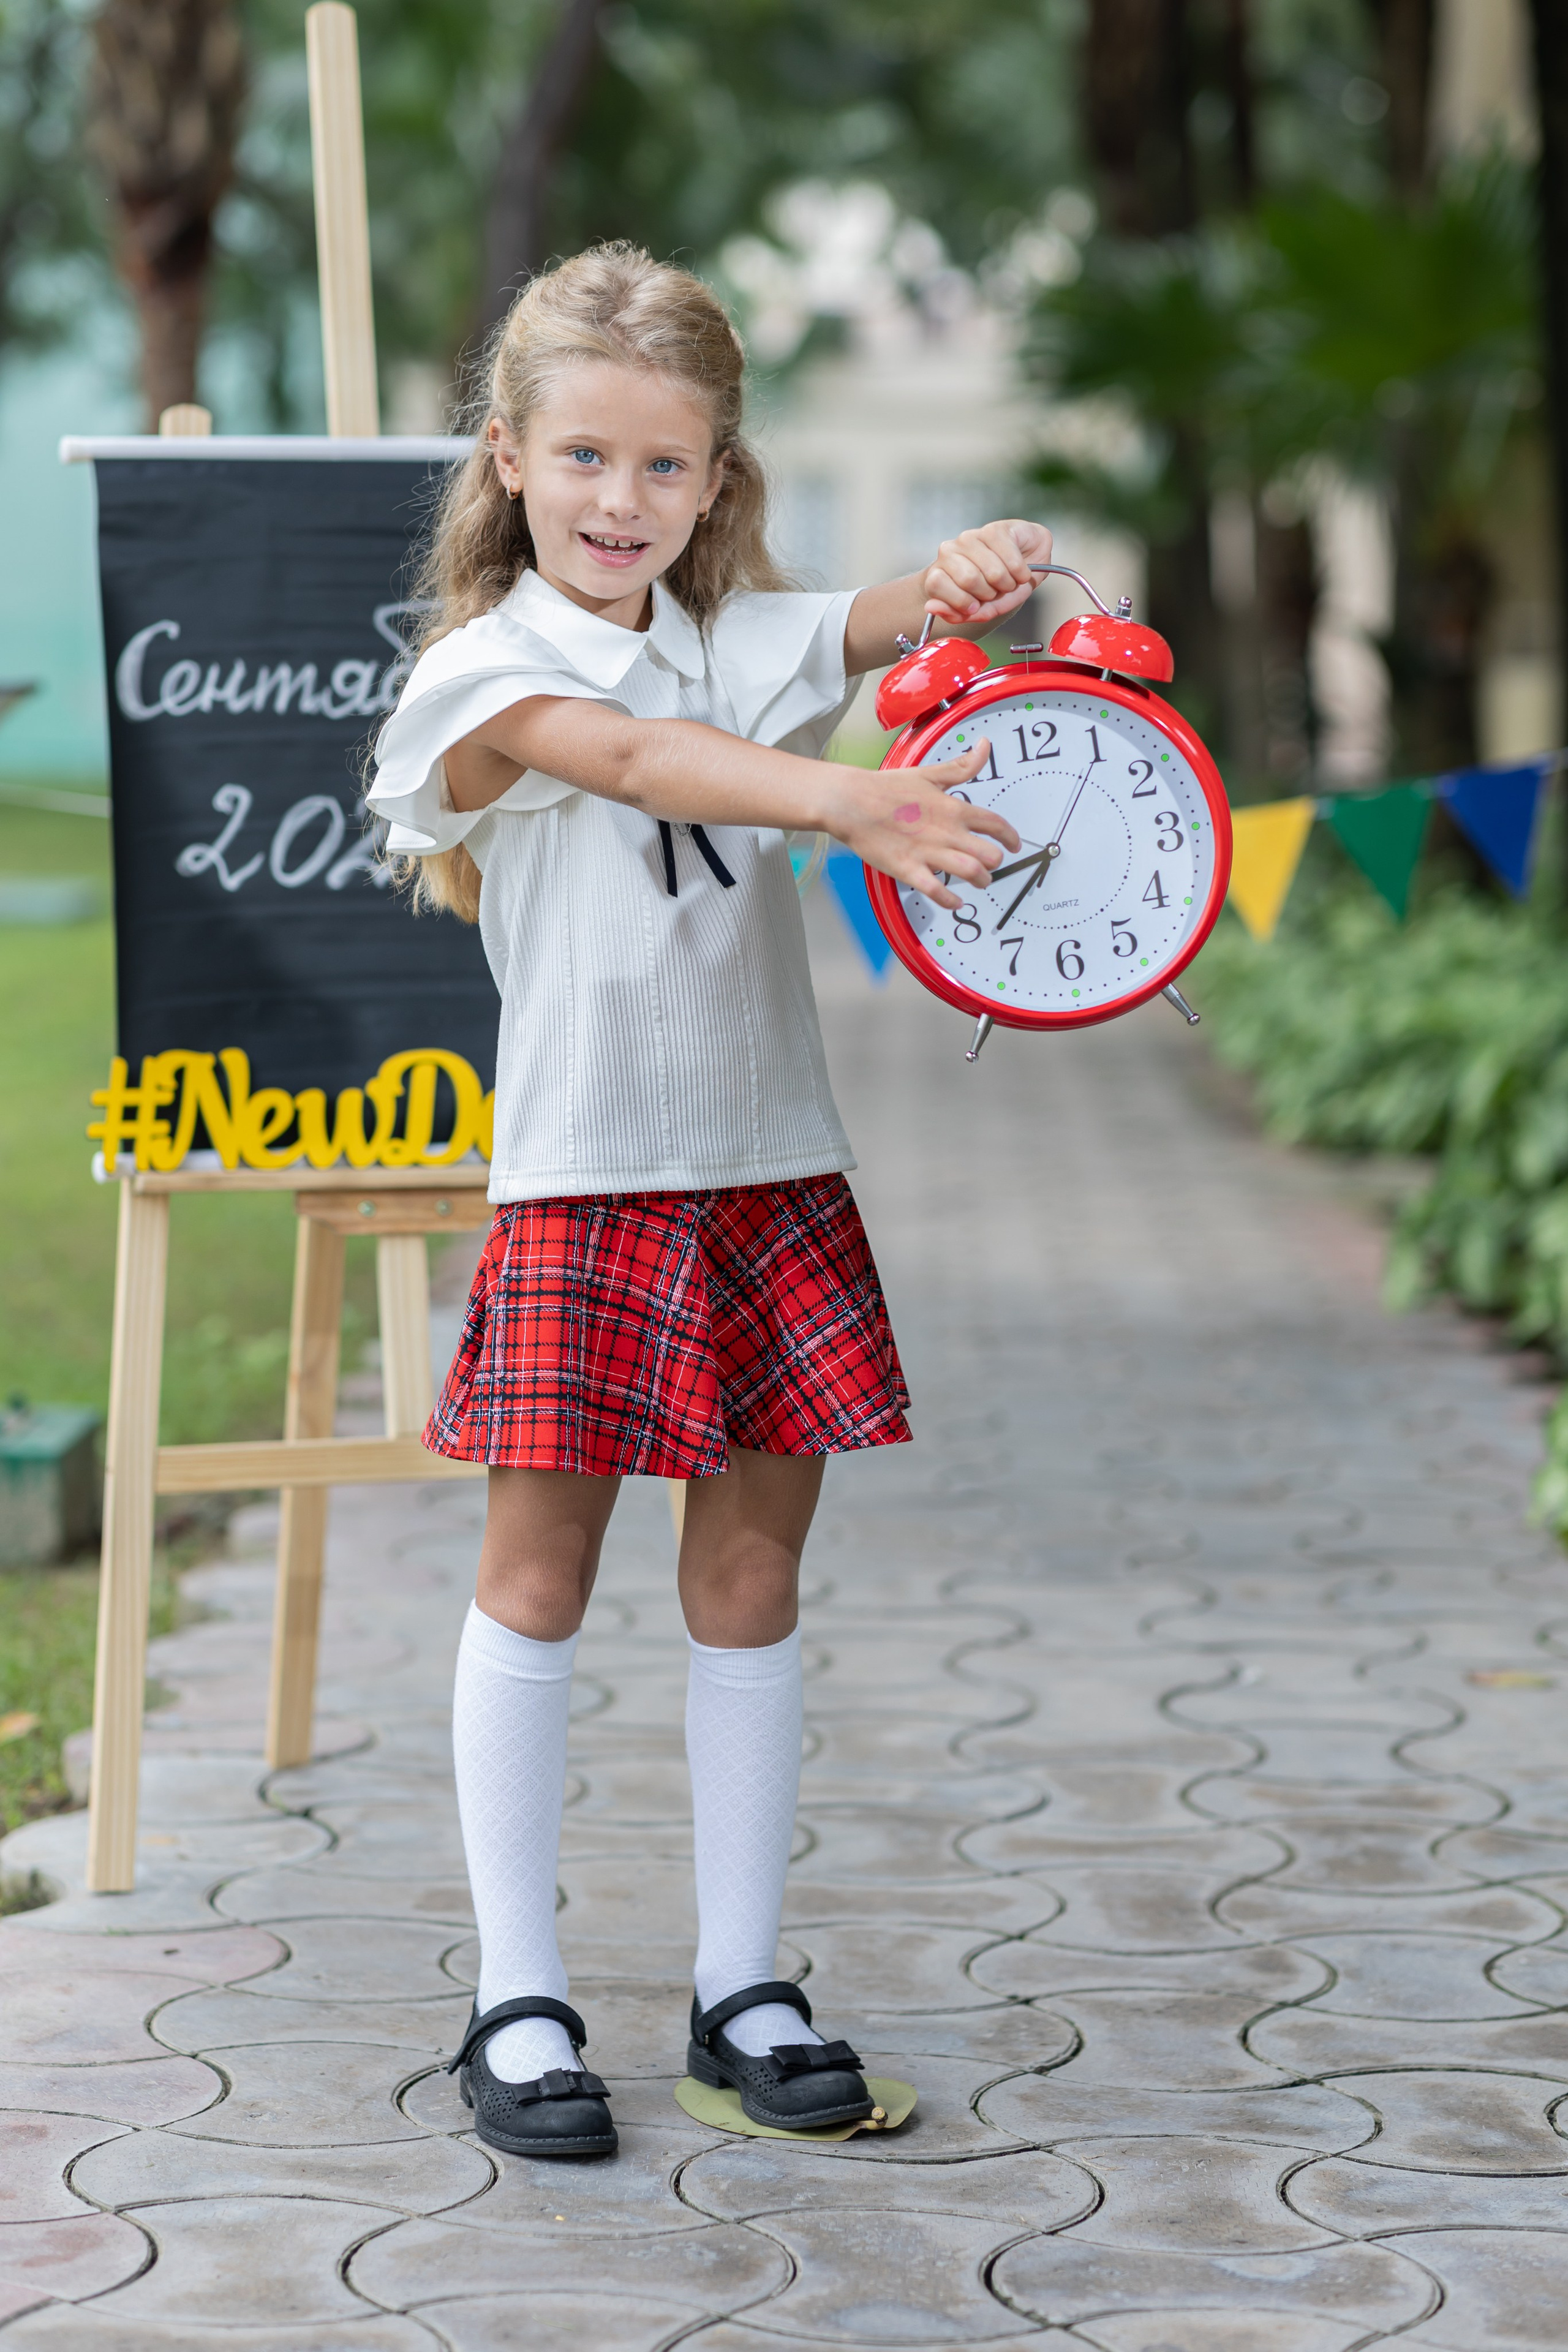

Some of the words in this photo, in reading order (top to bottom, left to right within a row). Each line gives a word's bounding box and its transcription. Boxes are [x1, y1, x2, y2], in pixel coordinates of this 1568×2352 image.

[1012, 721, 1060, 764] 12
[1085, 725, 1107, 764] 1
[1128, 760, 1157, 798] 2
[1154, 811, 1184, 852] 3
[1042, 899, 1080, 911] QUARTZ
[1142, 870, 1171, 910] 4
[952, 903, 982, 943] 8
[1110, 918, 1137, 957] 5
[1000, 937, 1024, 976] 7
[1056, 940, 1085, 980] 6
[86, 1047, 495, 1172] #NewD
